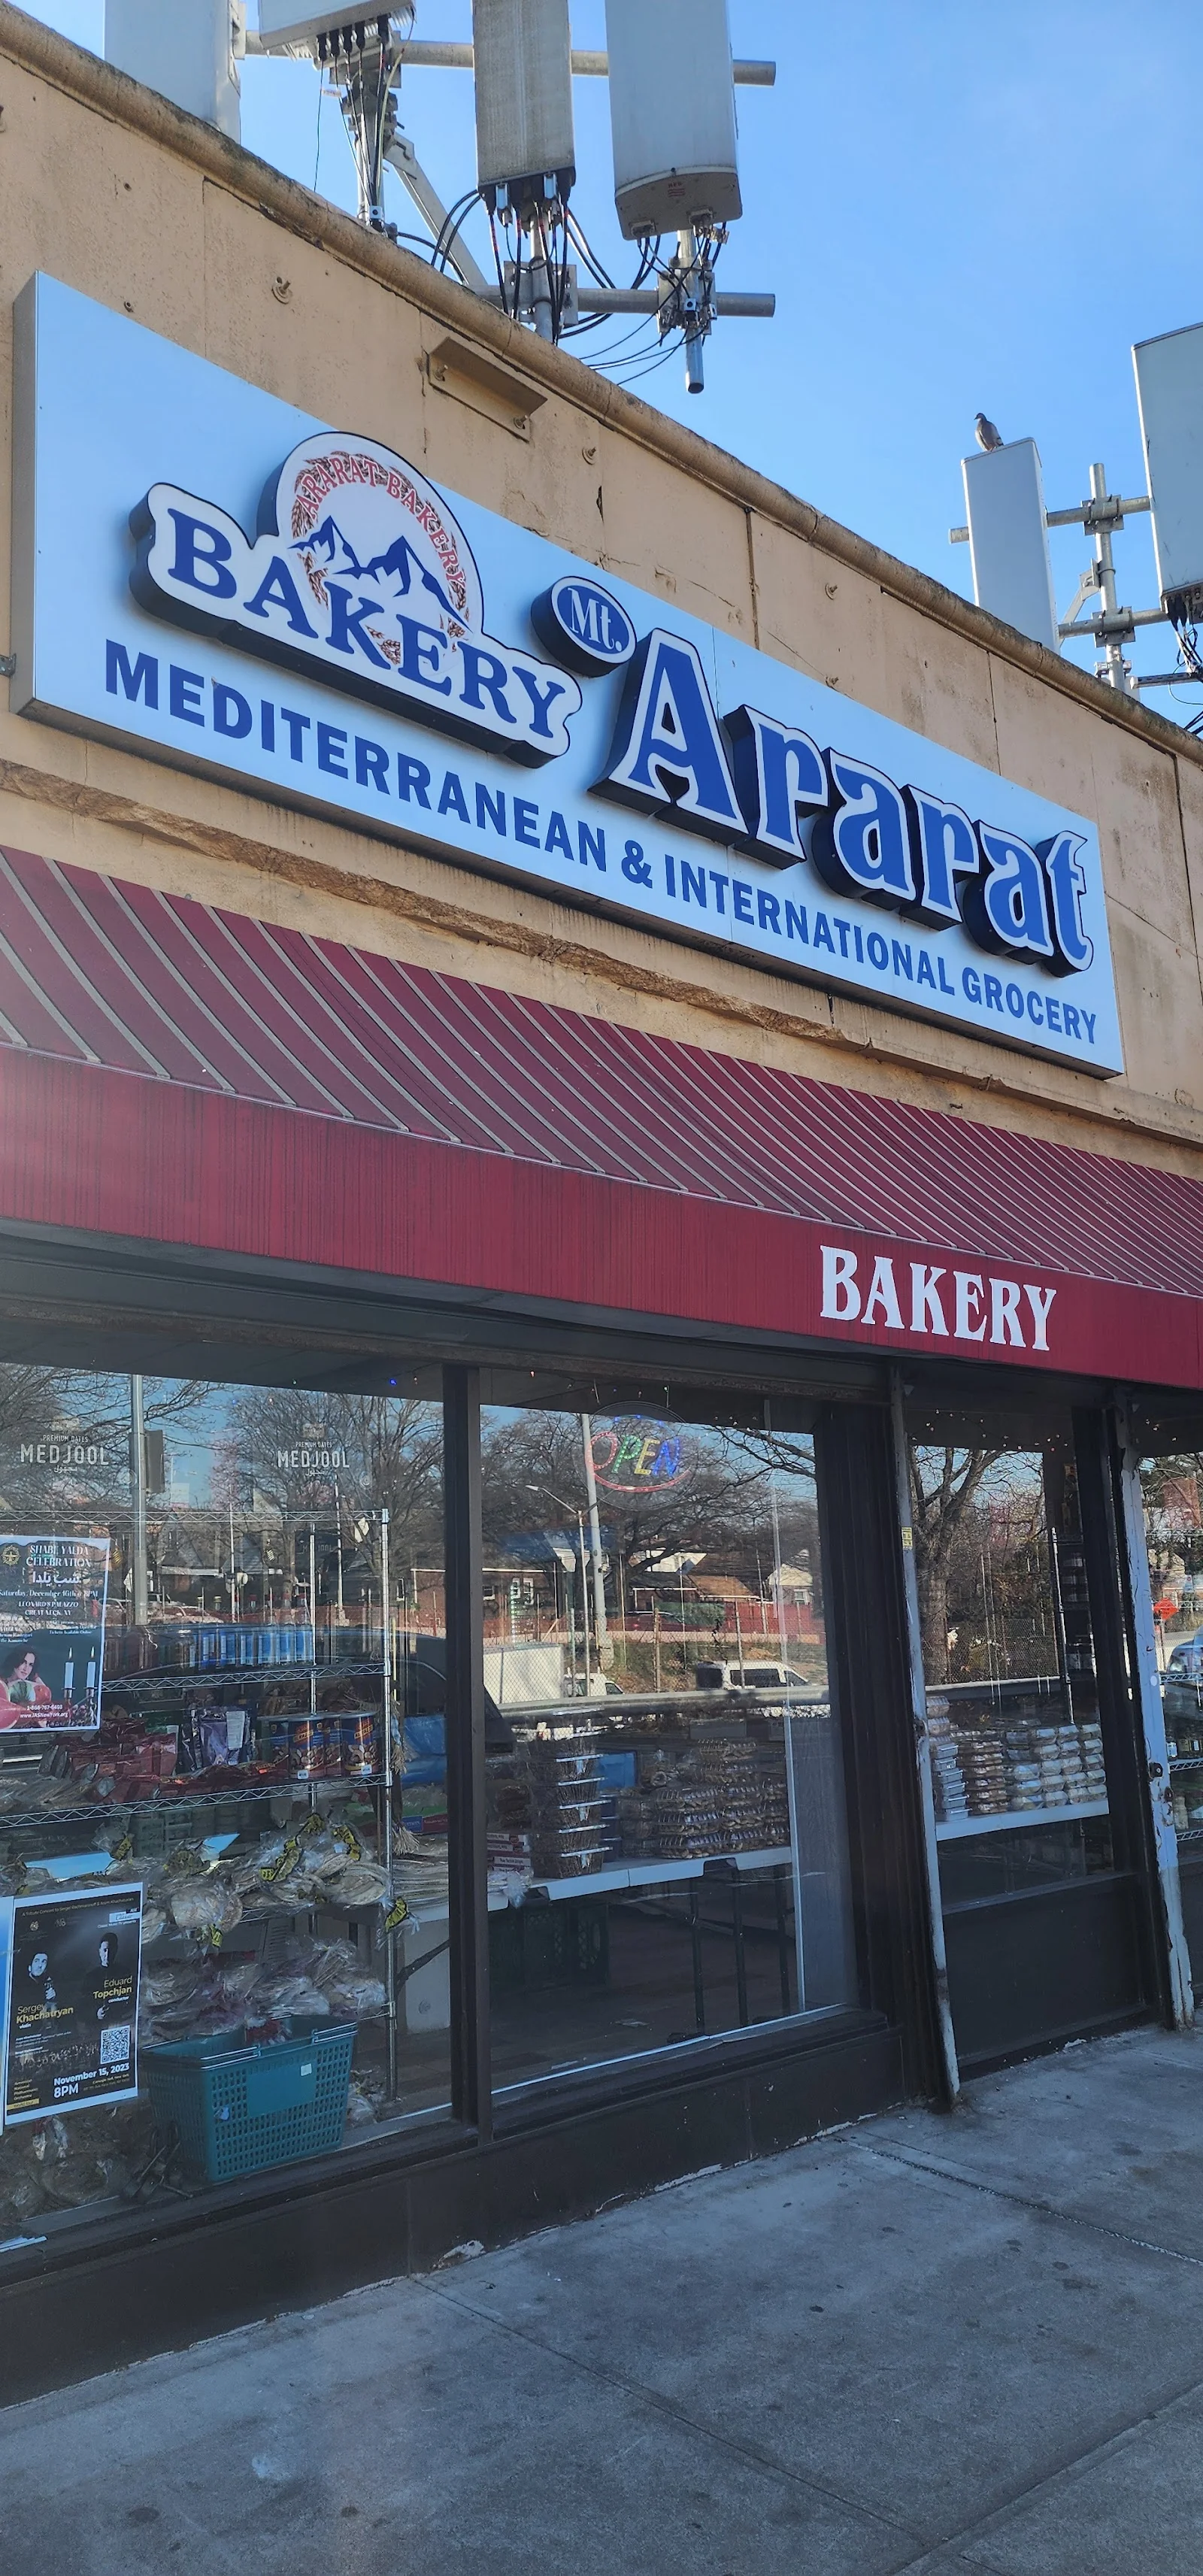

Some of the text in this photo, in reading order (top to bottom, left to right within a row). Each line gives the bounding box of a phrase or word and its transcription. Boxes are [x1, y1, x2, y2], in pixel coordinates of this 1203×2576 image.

[300, 457, 468, 587] ARARAT BAKERY
[167, 508, 565, 740] BAKERY
[567, 585, 1093, 971] Mt. Ararat
[105, 638, 1097, 1044] MEDITERRANEAN & INTERNATIONAL GROCERY
[820, 1245, 1056, 1351] BAKERY
[20, 1444, 108, 1465] MEDJOOL
[277, 1450, 350, 1468] MEDJOOL
[586, 1431, 680, 1478] OPEN
[62, 1546, 89, 1555] YALDA
[26, 1556, 91, 1567] CELEBRATION
[104, 1976, 132, 1988] Eduard
[93, 1987, 132, 2000] Topchjan
[16, 2006, 74, 2024] Khachatryan
[17, 2003, 45, 2015] Sergey
[54, 2071, 97, 2087] November
[98, 2067, 109, 2077] 15,
[111, 2062, 130, 2074] 2023
[54, 2083, 79, 2099] 8PM
